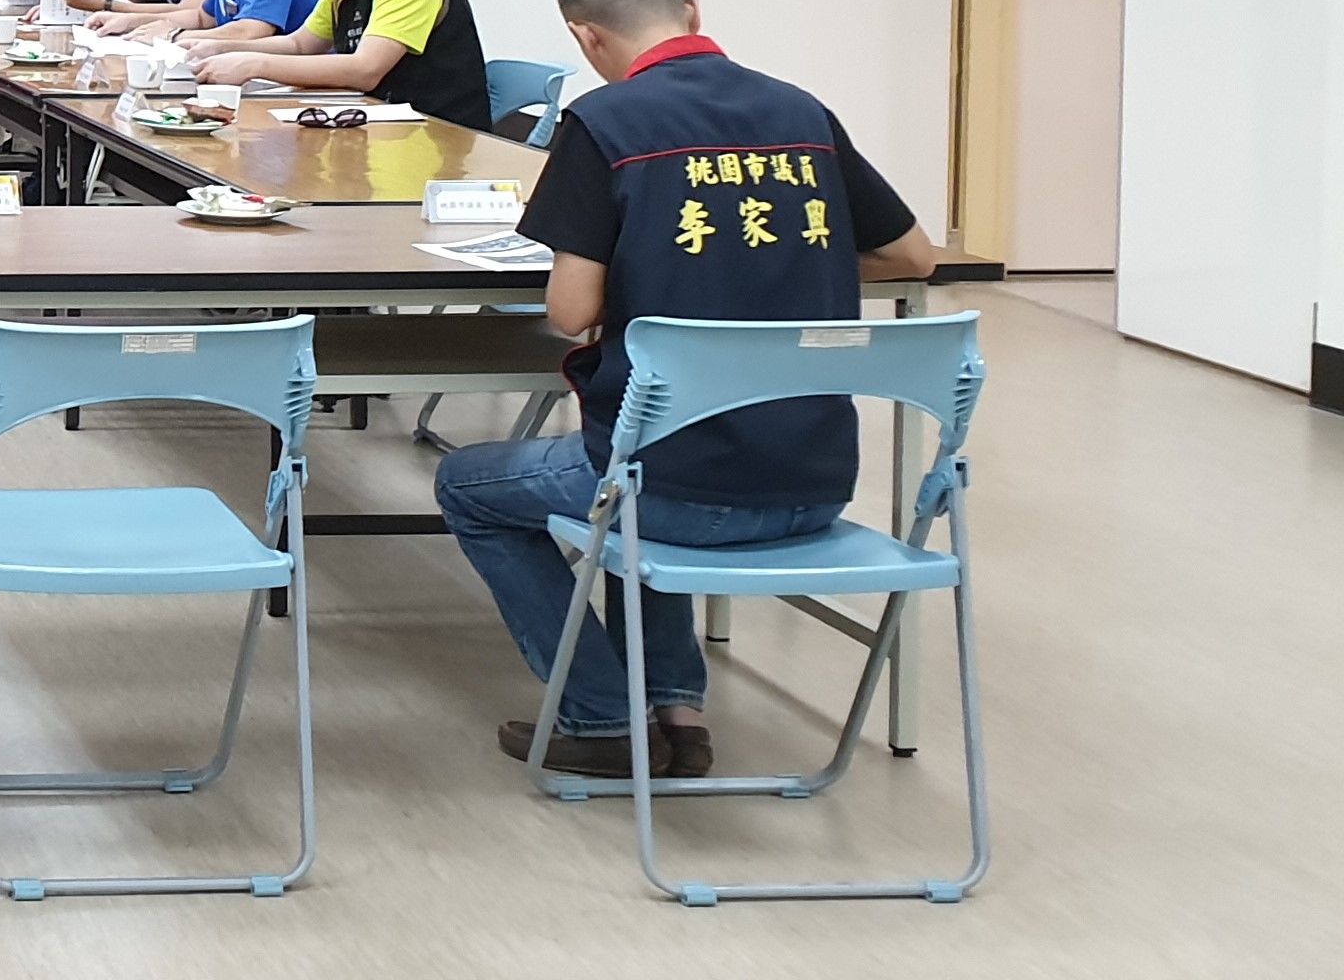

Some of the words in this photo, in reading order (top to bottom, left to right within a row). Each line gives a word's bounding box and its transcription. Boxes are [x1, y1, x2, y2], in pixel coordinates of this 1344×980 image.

[685, 152, 818, 188] 桃園市議員
[674, 196, 831, 254] 李家興
